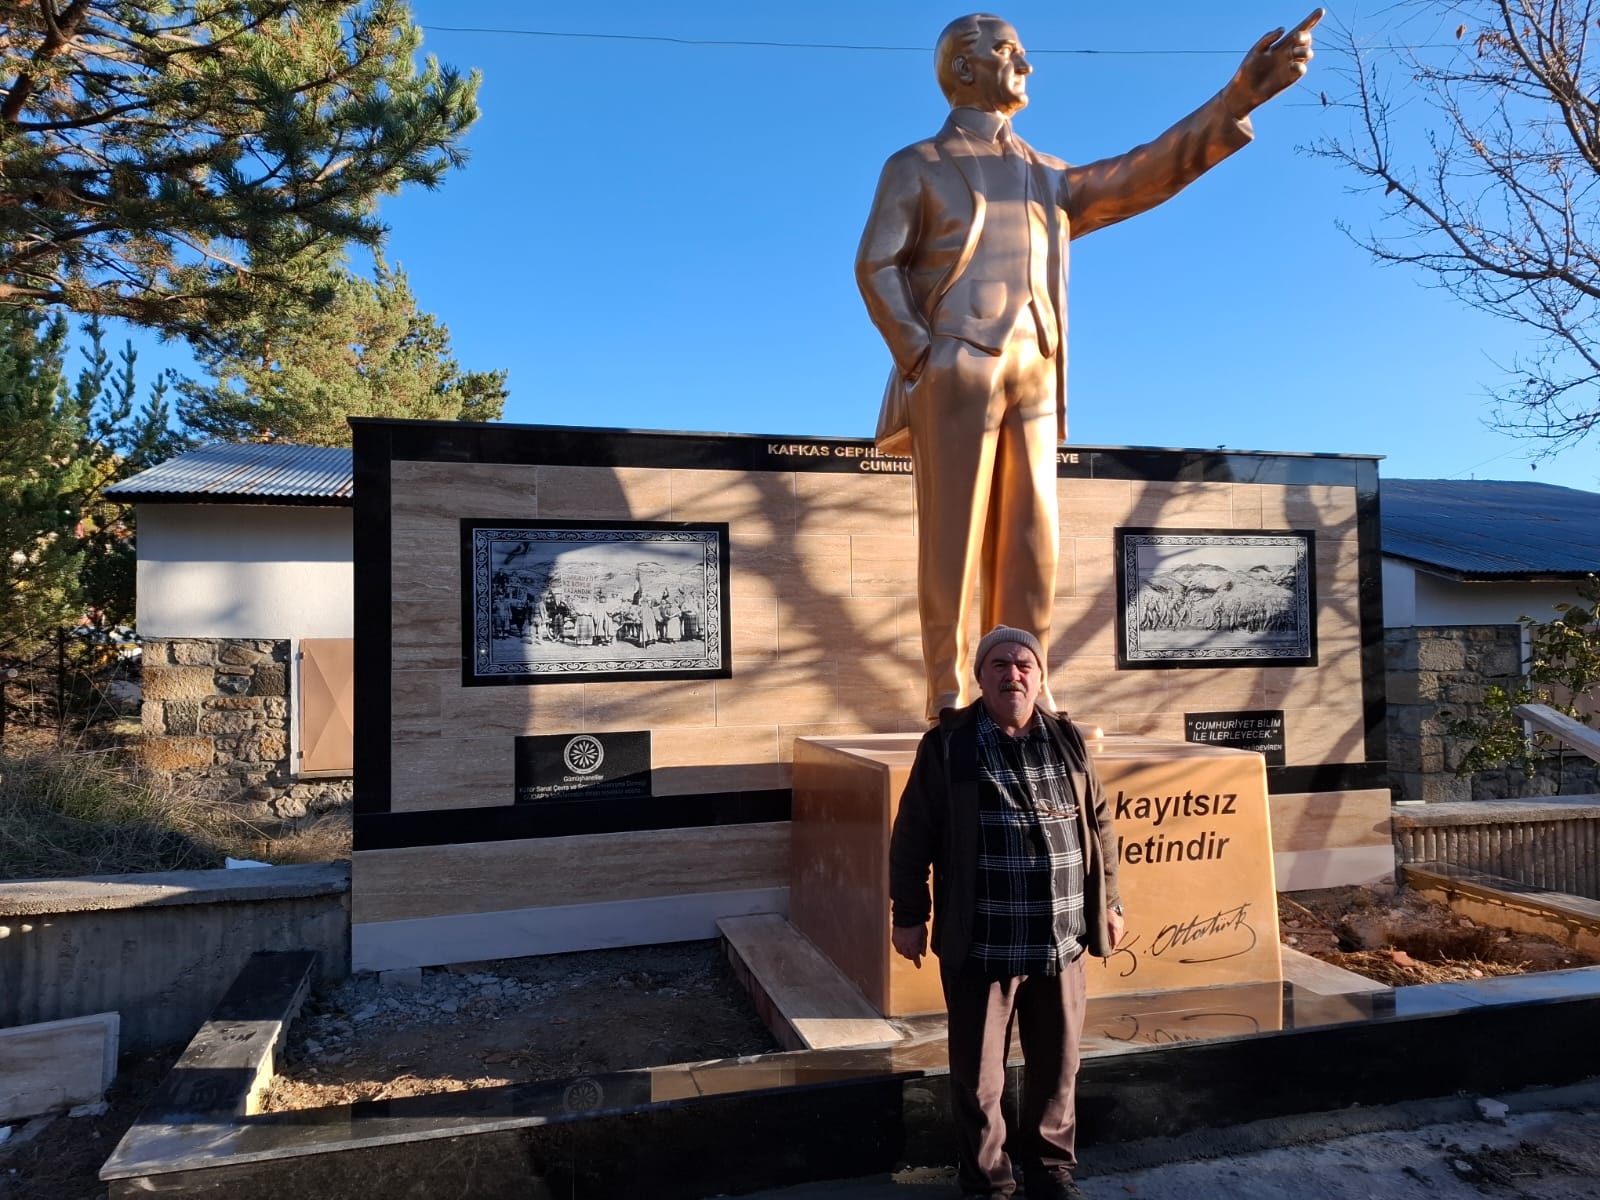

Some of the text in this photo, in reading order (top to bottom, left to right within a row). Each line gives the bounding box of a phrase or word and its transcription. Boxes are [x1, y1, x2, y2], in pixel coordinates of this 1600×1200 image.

[768, 443, 829, 456] KAFKAS
[834, 446, 912, 459] CEPHE
[860, 460, 912, 472] CUMHU
[1192, 731, 1207, 741] İLE
[1115, 789, 1238, 826] kayıtsız
[1118, 831, 1230, 865] letindir
